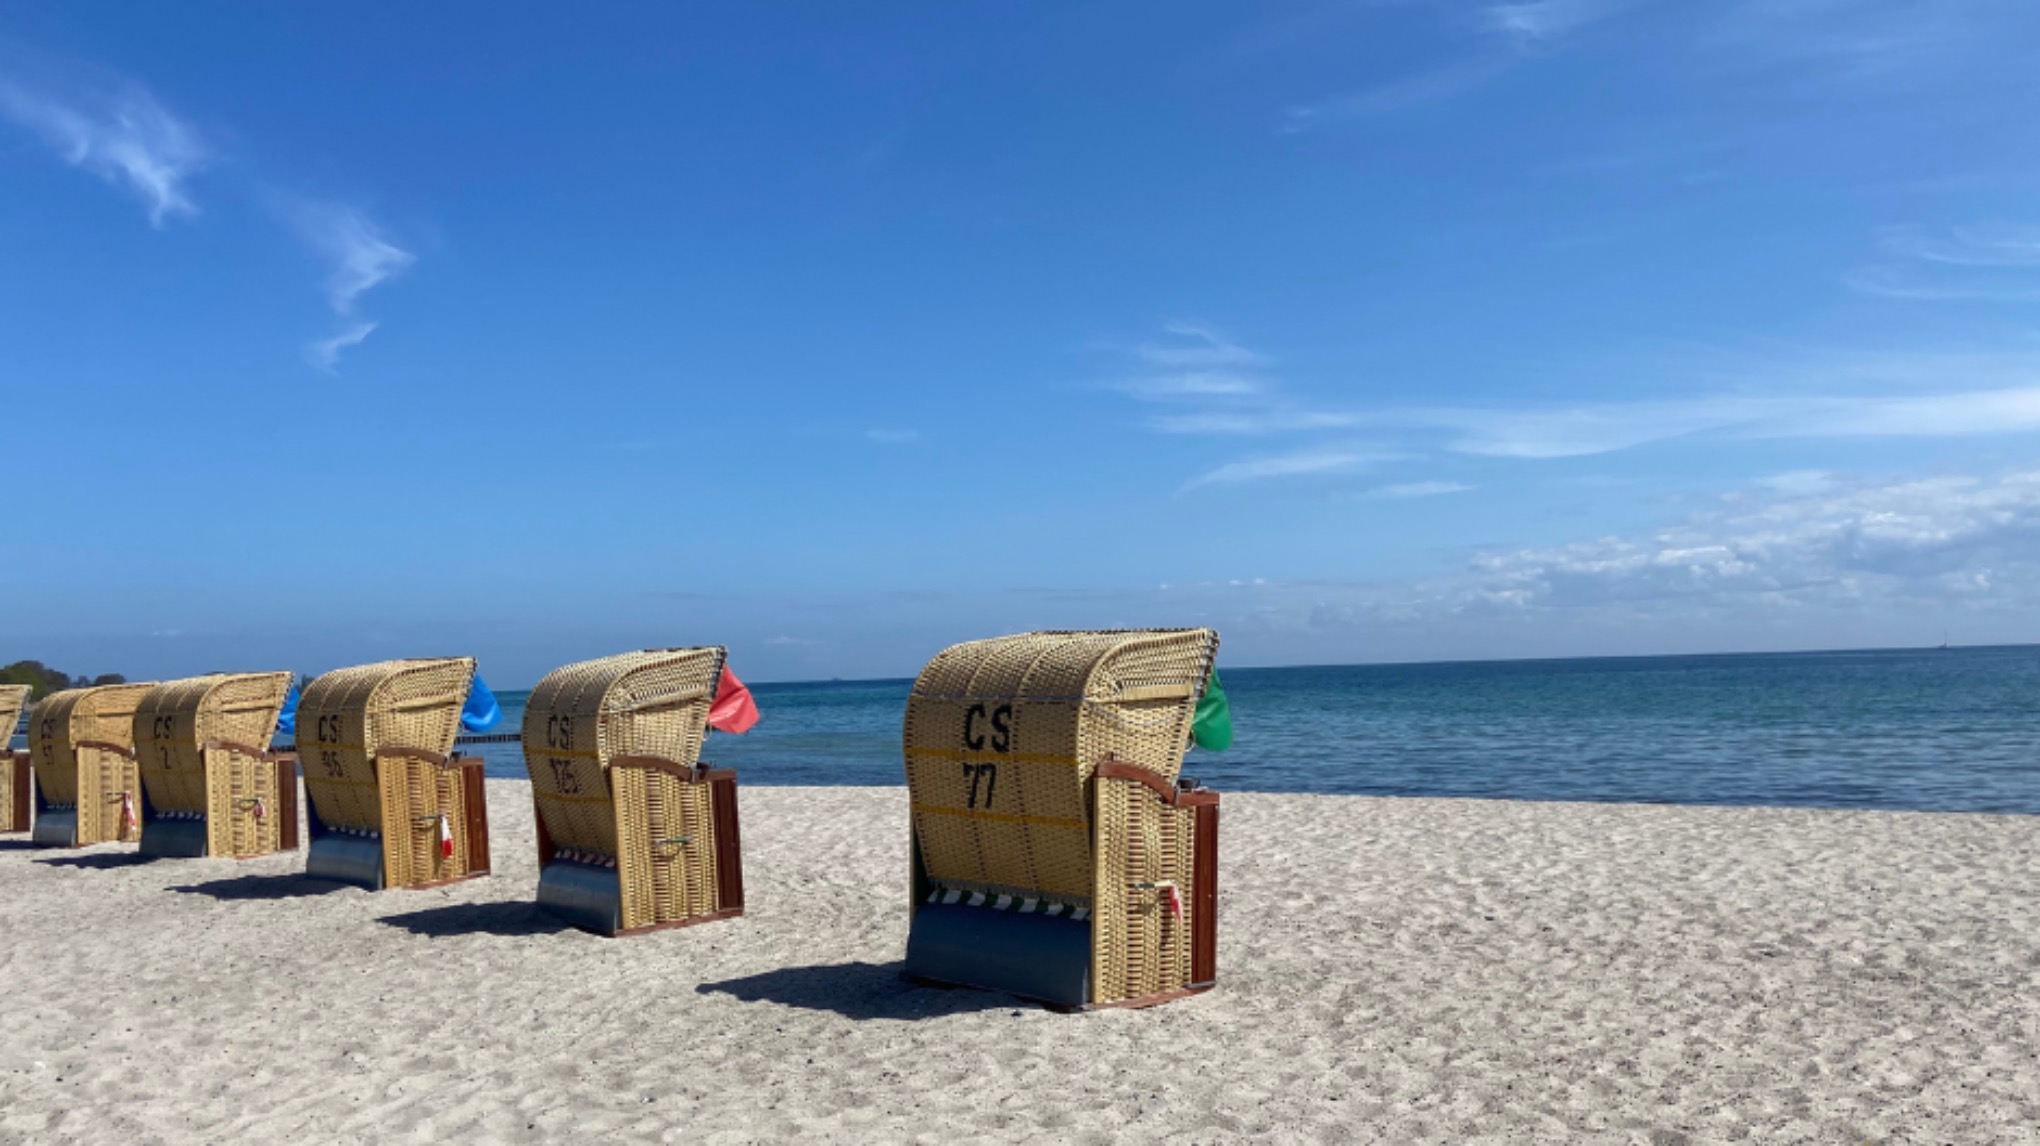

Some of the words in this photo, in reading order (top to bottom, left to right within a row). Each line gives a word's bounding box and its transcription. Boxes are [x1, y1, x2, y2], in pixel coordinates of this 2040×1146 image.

[153, 716, 172, 739] CS
[319, 714, 338, 744] CS
[547, 714, 569, 750] CS
[964, 704, 1012, 753] CS
[963, 762, 997, 808] 77
